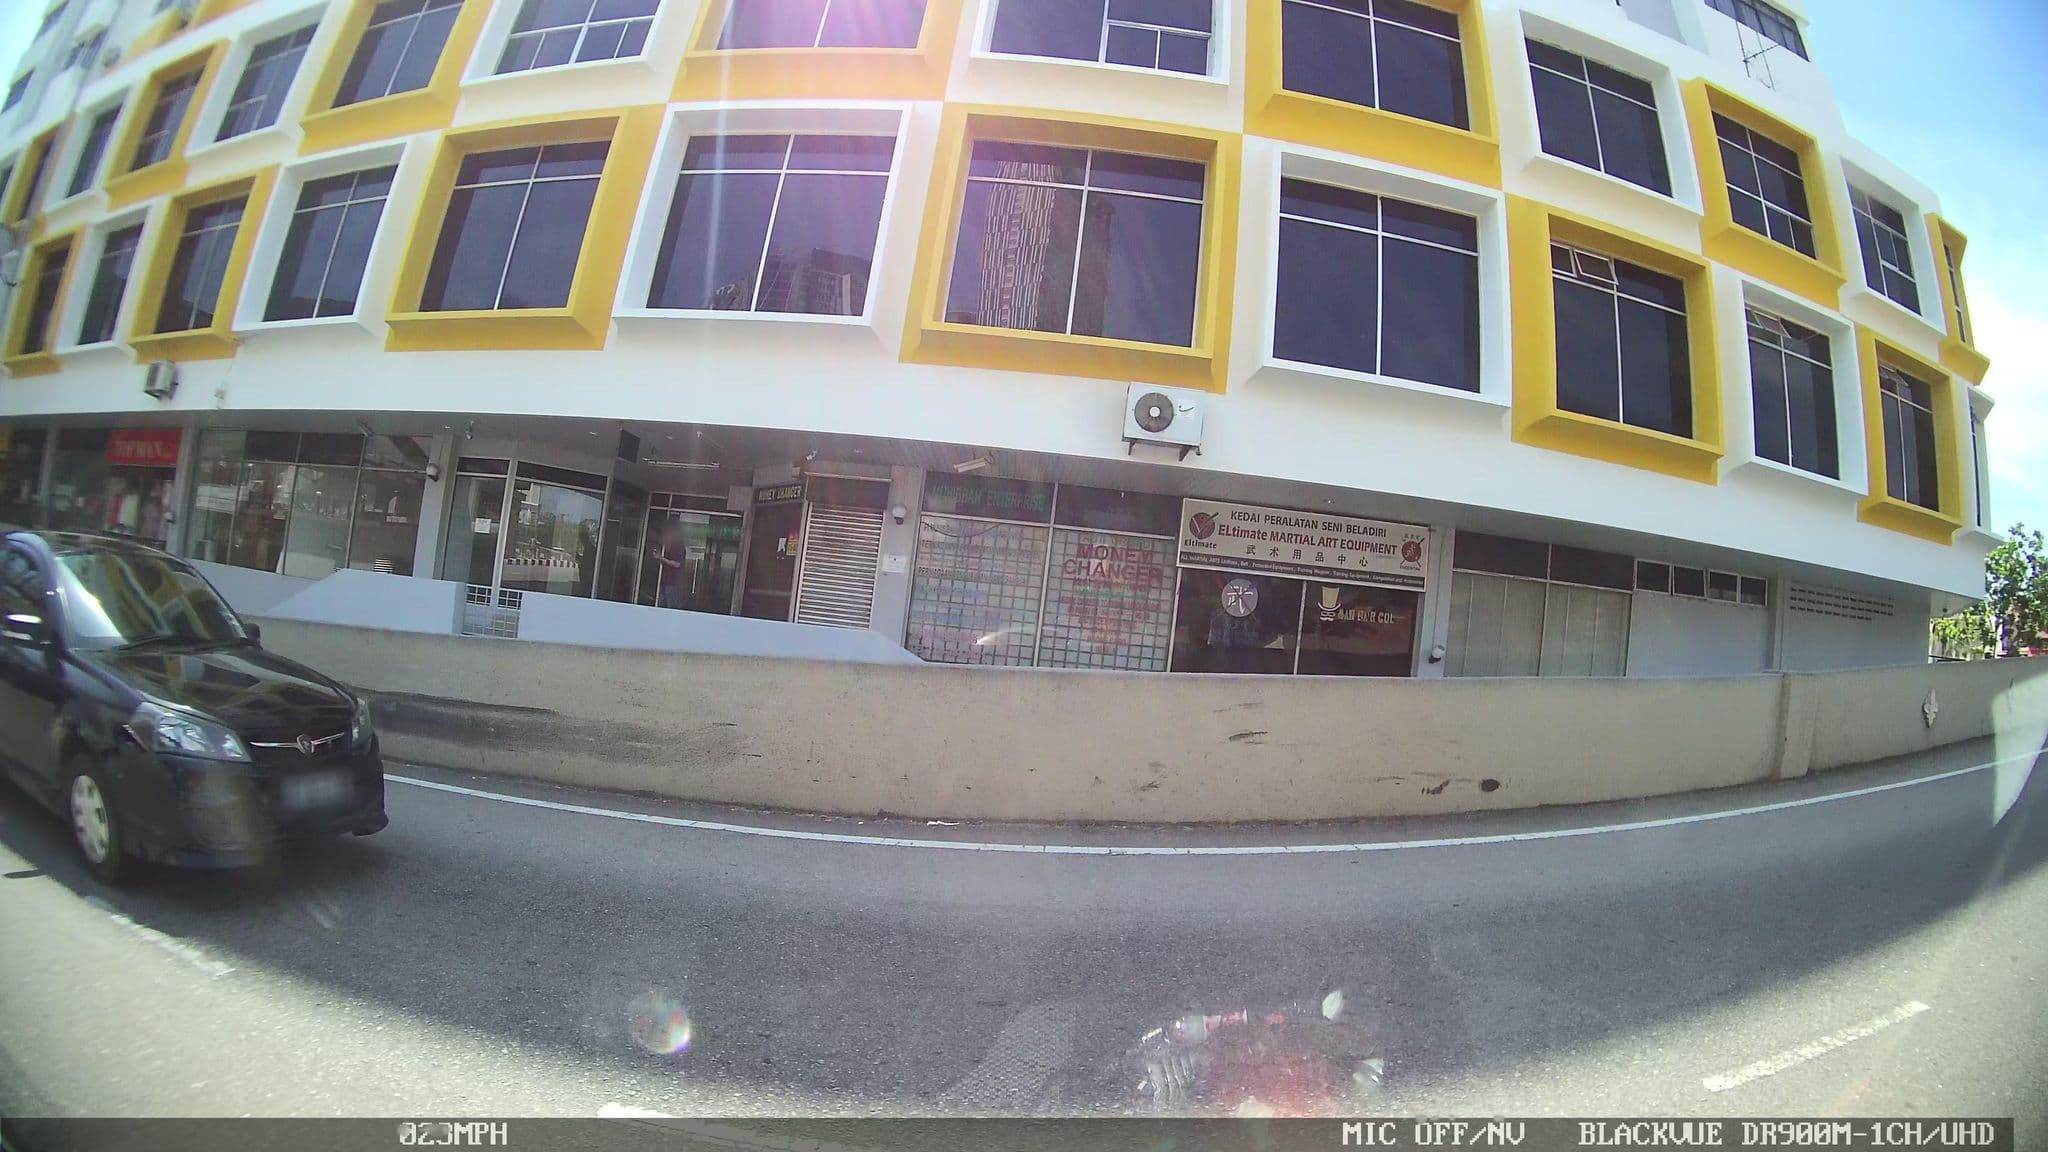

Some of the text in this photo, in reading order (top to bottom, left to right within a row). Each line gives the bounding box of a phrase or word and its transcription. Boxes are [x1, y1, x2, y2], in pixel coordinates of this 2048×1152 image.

[1230, 510, 1260, 523] KEDAI
[1264, 514, 1318, 530] PERALATAN
[1322, 520, 1343, 533] SENI
[1346, 523, 1387, 538] BELADIRI
[1218, 524, 1398, 555] ELtimate MARTIAL ART EQUIPMENT
[1077, 544, 1153, 564] MONEY
[1063, 559, 1163, 582] CHANGER
